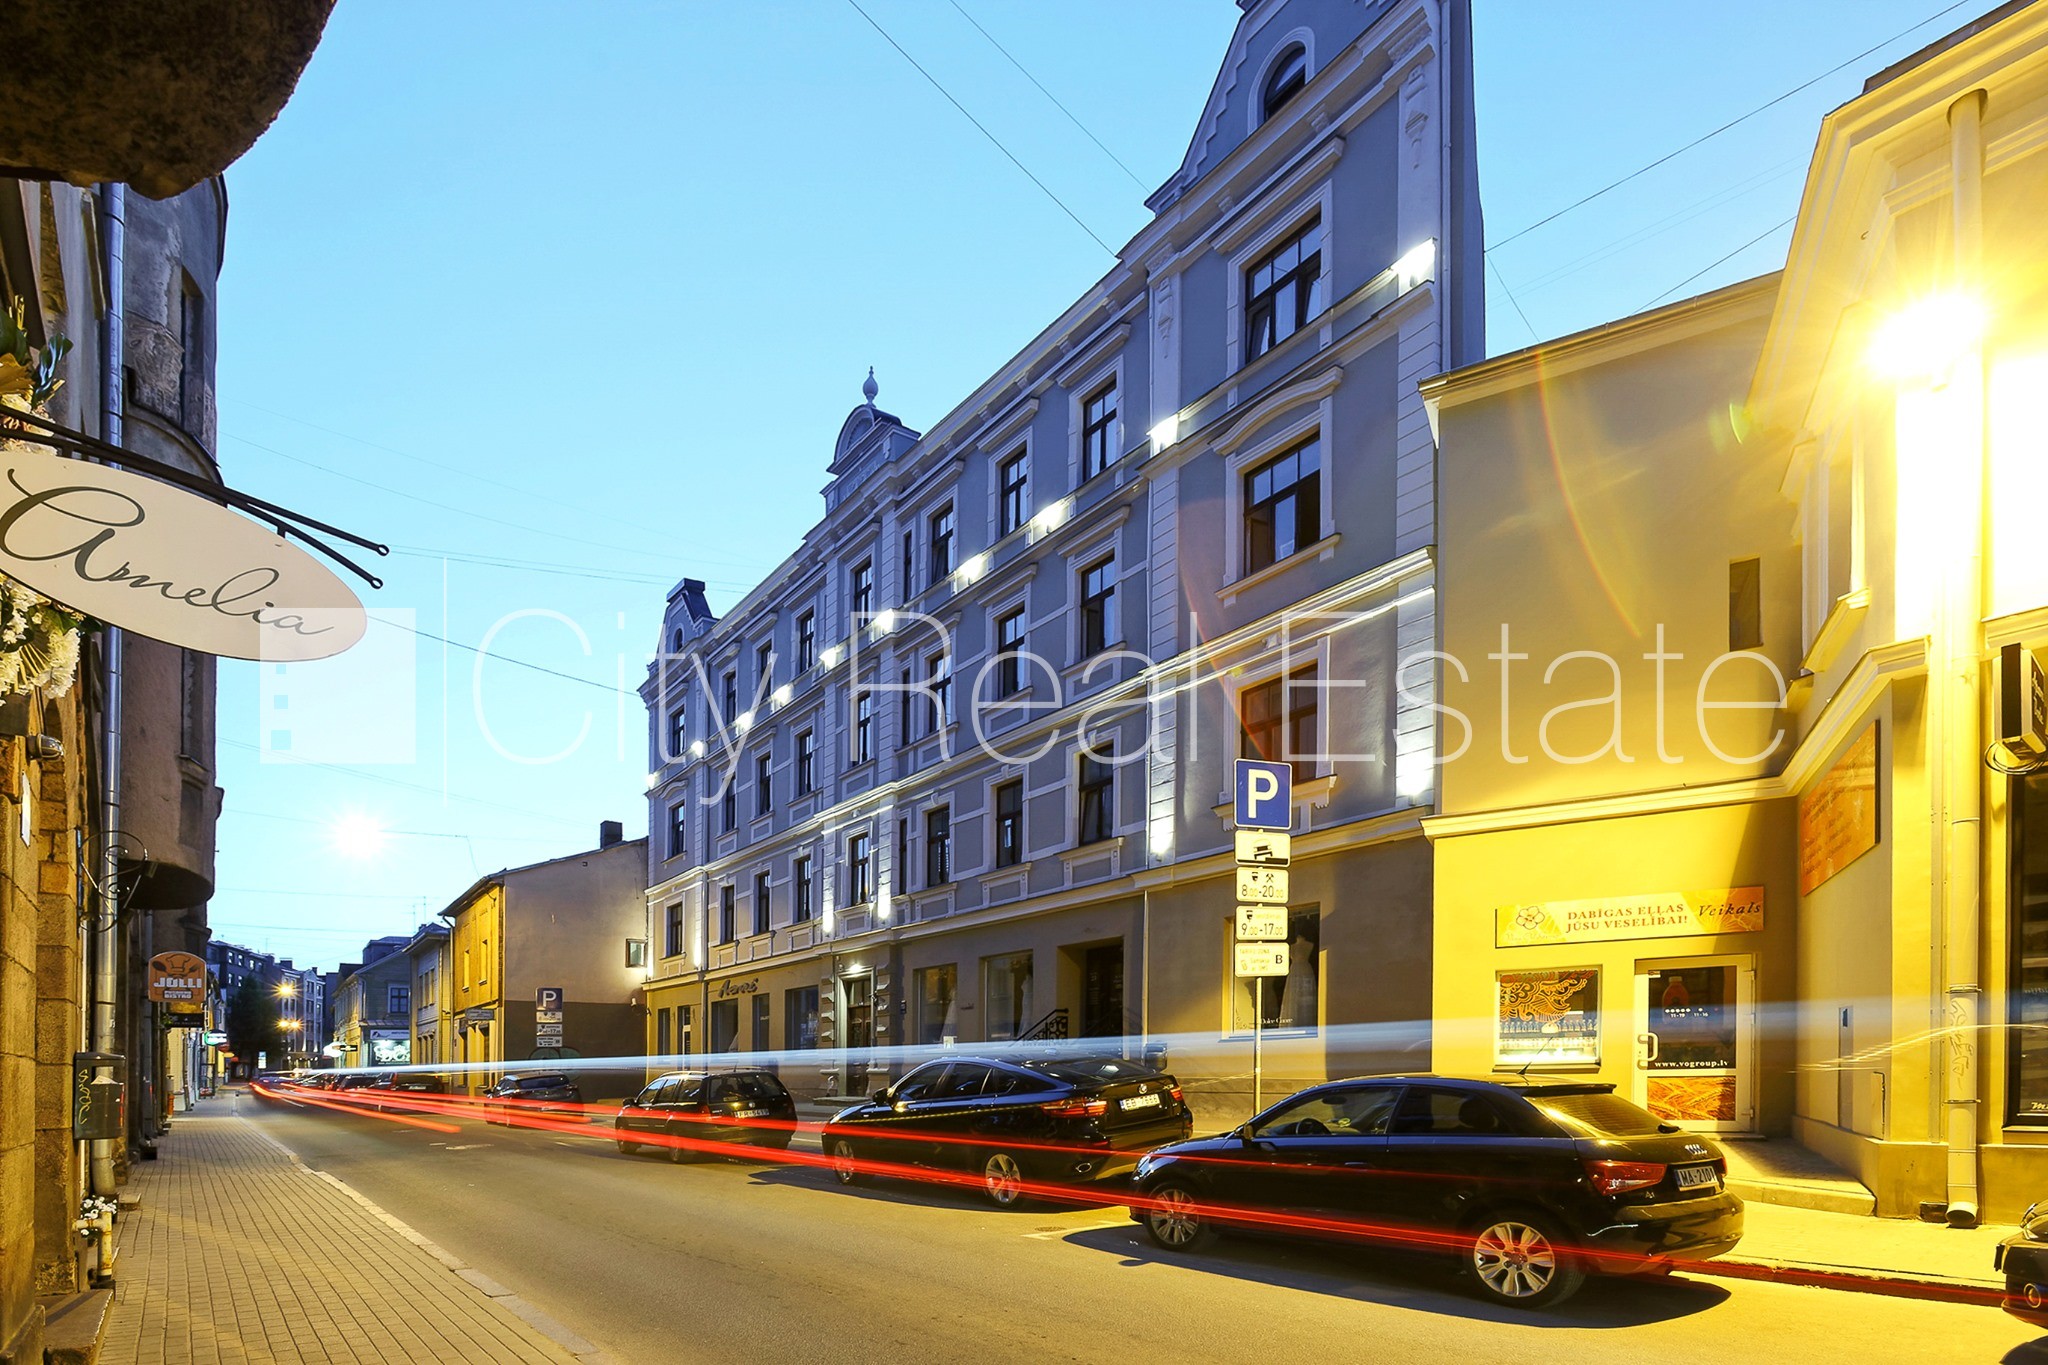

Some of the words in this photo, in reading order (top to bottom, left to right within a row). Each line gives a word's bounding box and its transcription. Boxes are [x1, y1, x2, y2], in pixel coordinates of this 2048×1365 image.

[1, 467, 335, 636] Amelia
[1248, 768, 1279, 819] P
[1567, 906, 1633, 920] DABĪGAS
[1638, 903, 1685, 917] EĻĻAS
[1698, 900, 1762, 917] Veikals
[1566, 919, 1602, 933] JŪSU
[1606, 915, 1688, 929] VESELĪBAI!
[1275, 954, 1283, 964] B
[153, 977, 202, 988] JOLLI
[542, 990, 557, 1007] P
[1654, 1059, 1728, 1067] www.vogroup.lv
[1679, 1167, 1716, 1185] MA-2101
